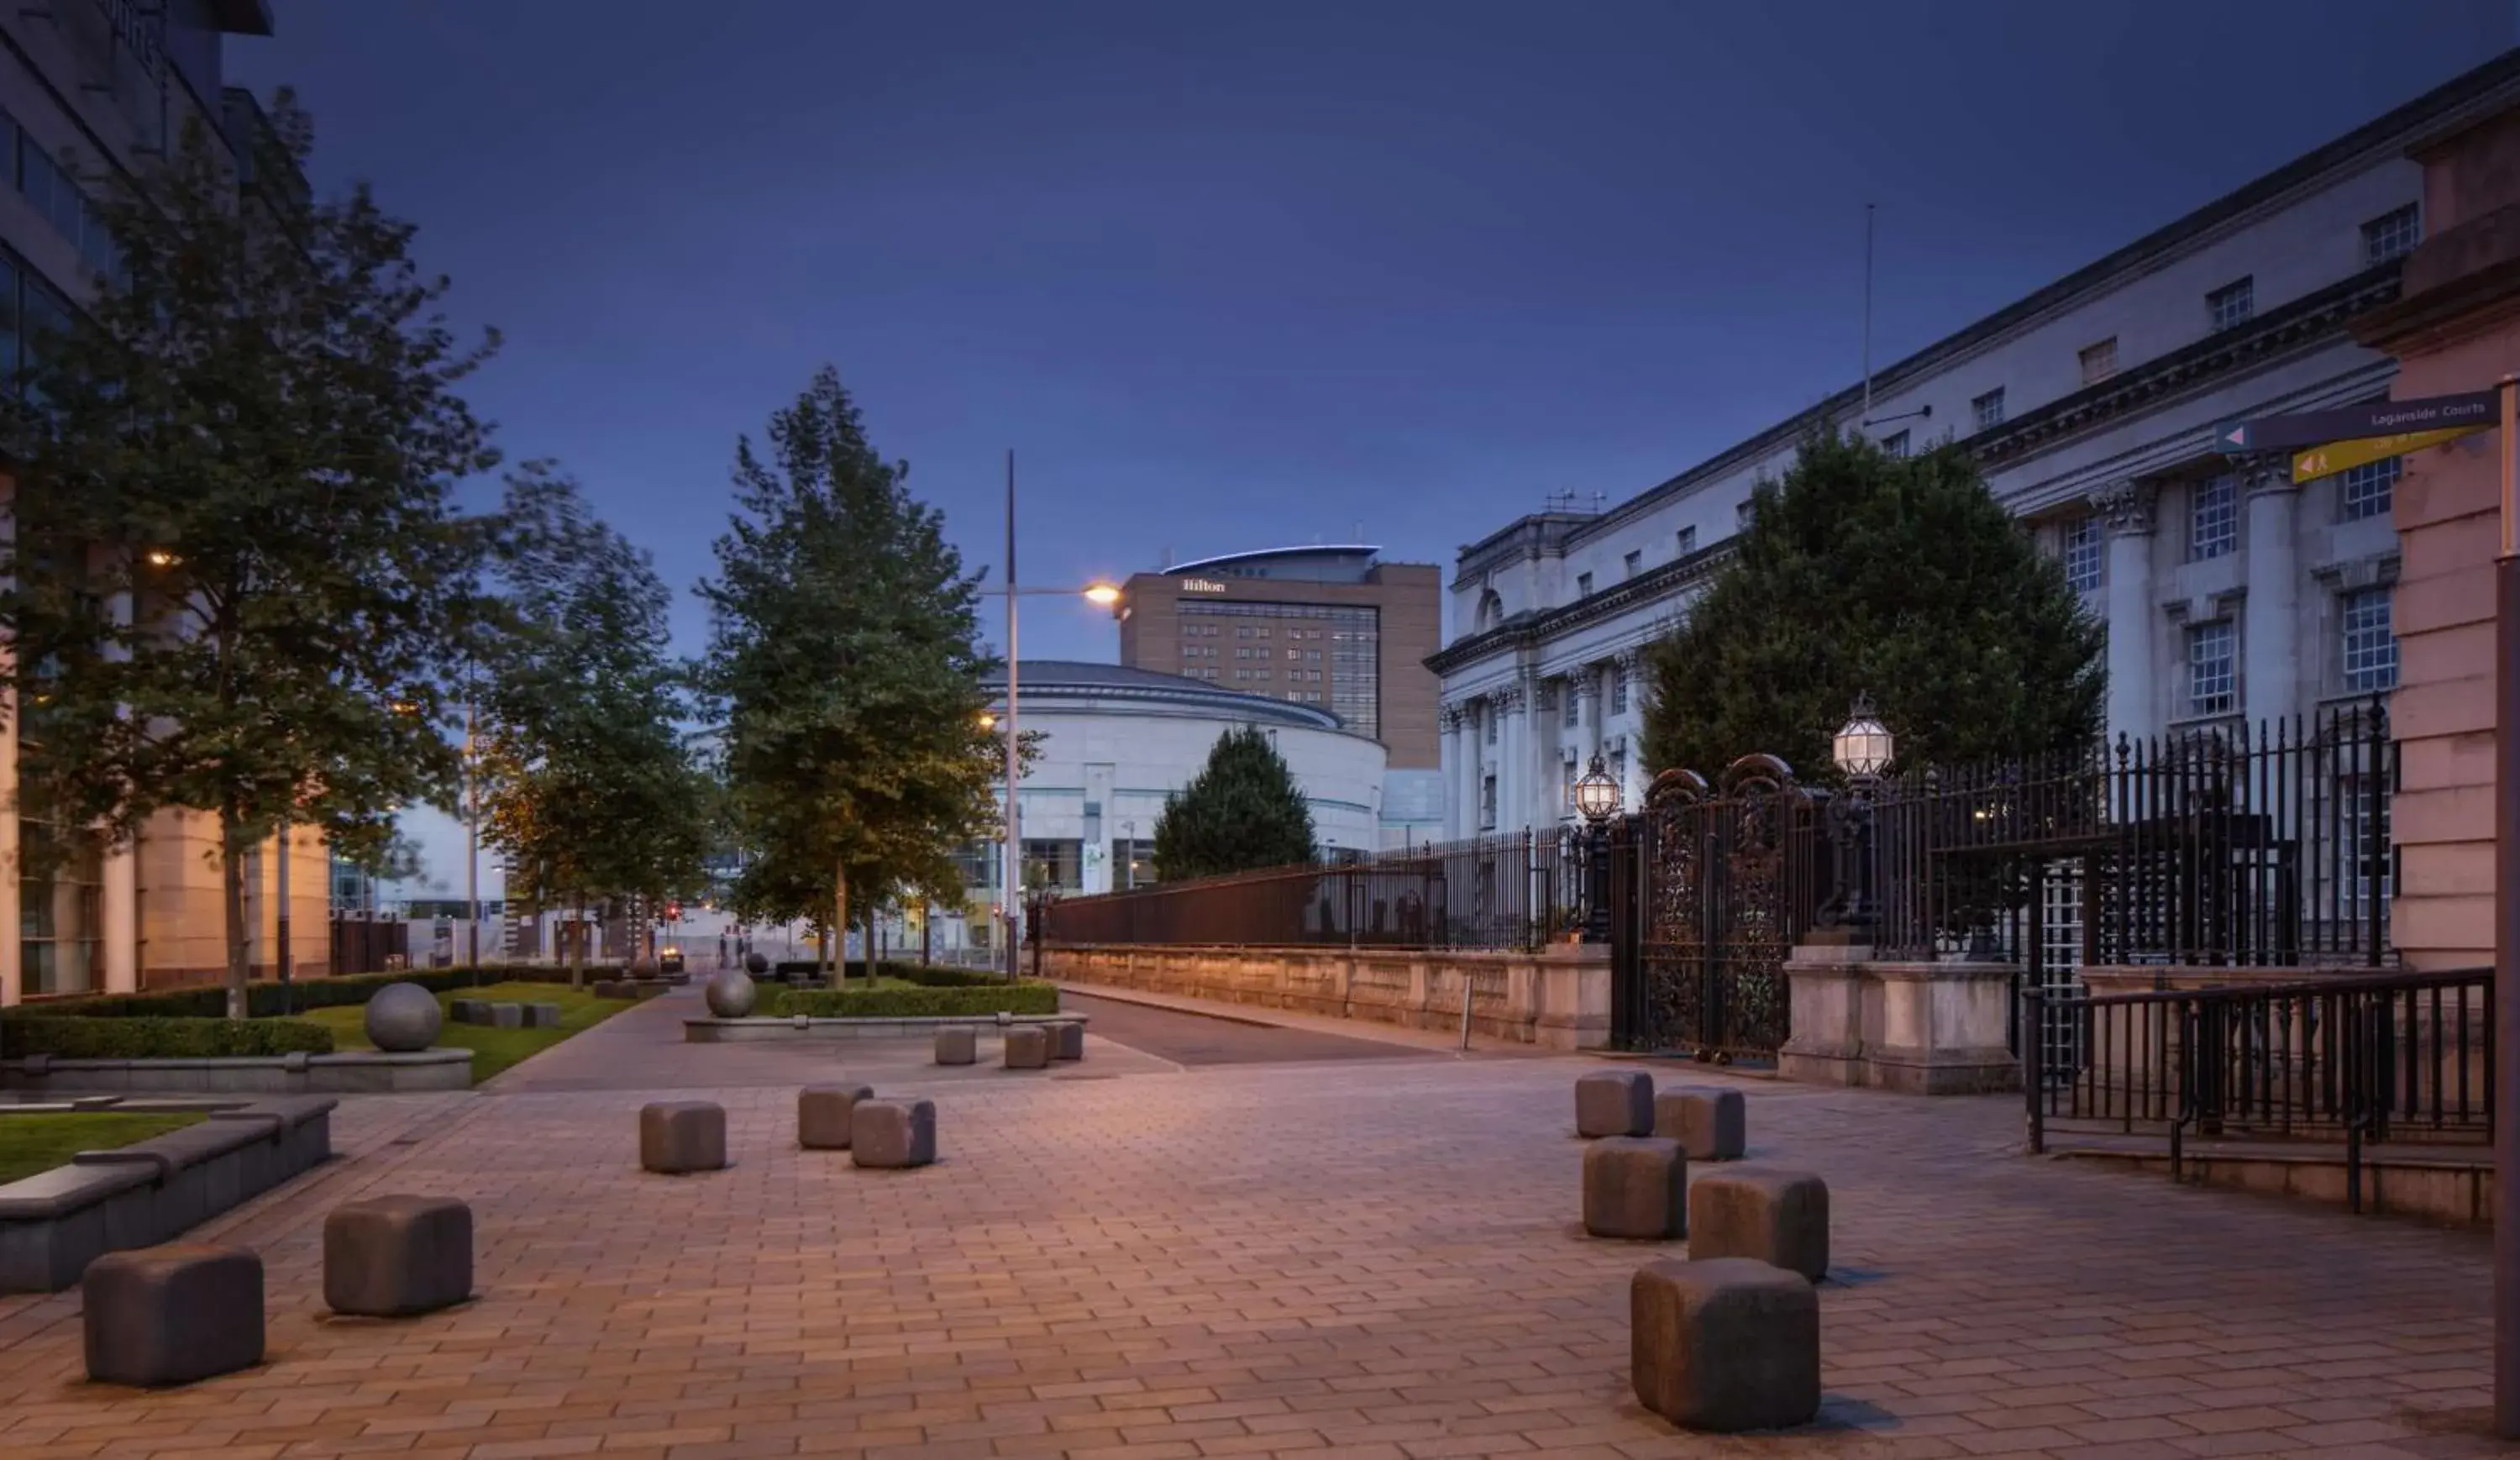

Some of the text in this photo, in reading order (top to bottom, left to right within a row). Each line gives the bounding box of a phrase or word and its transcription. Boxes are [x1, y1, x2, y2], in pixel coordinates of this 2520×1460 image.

[2371, 403, 2486, 425] Laganside Courts
[1183, 578, 1226, 592] Hilton
